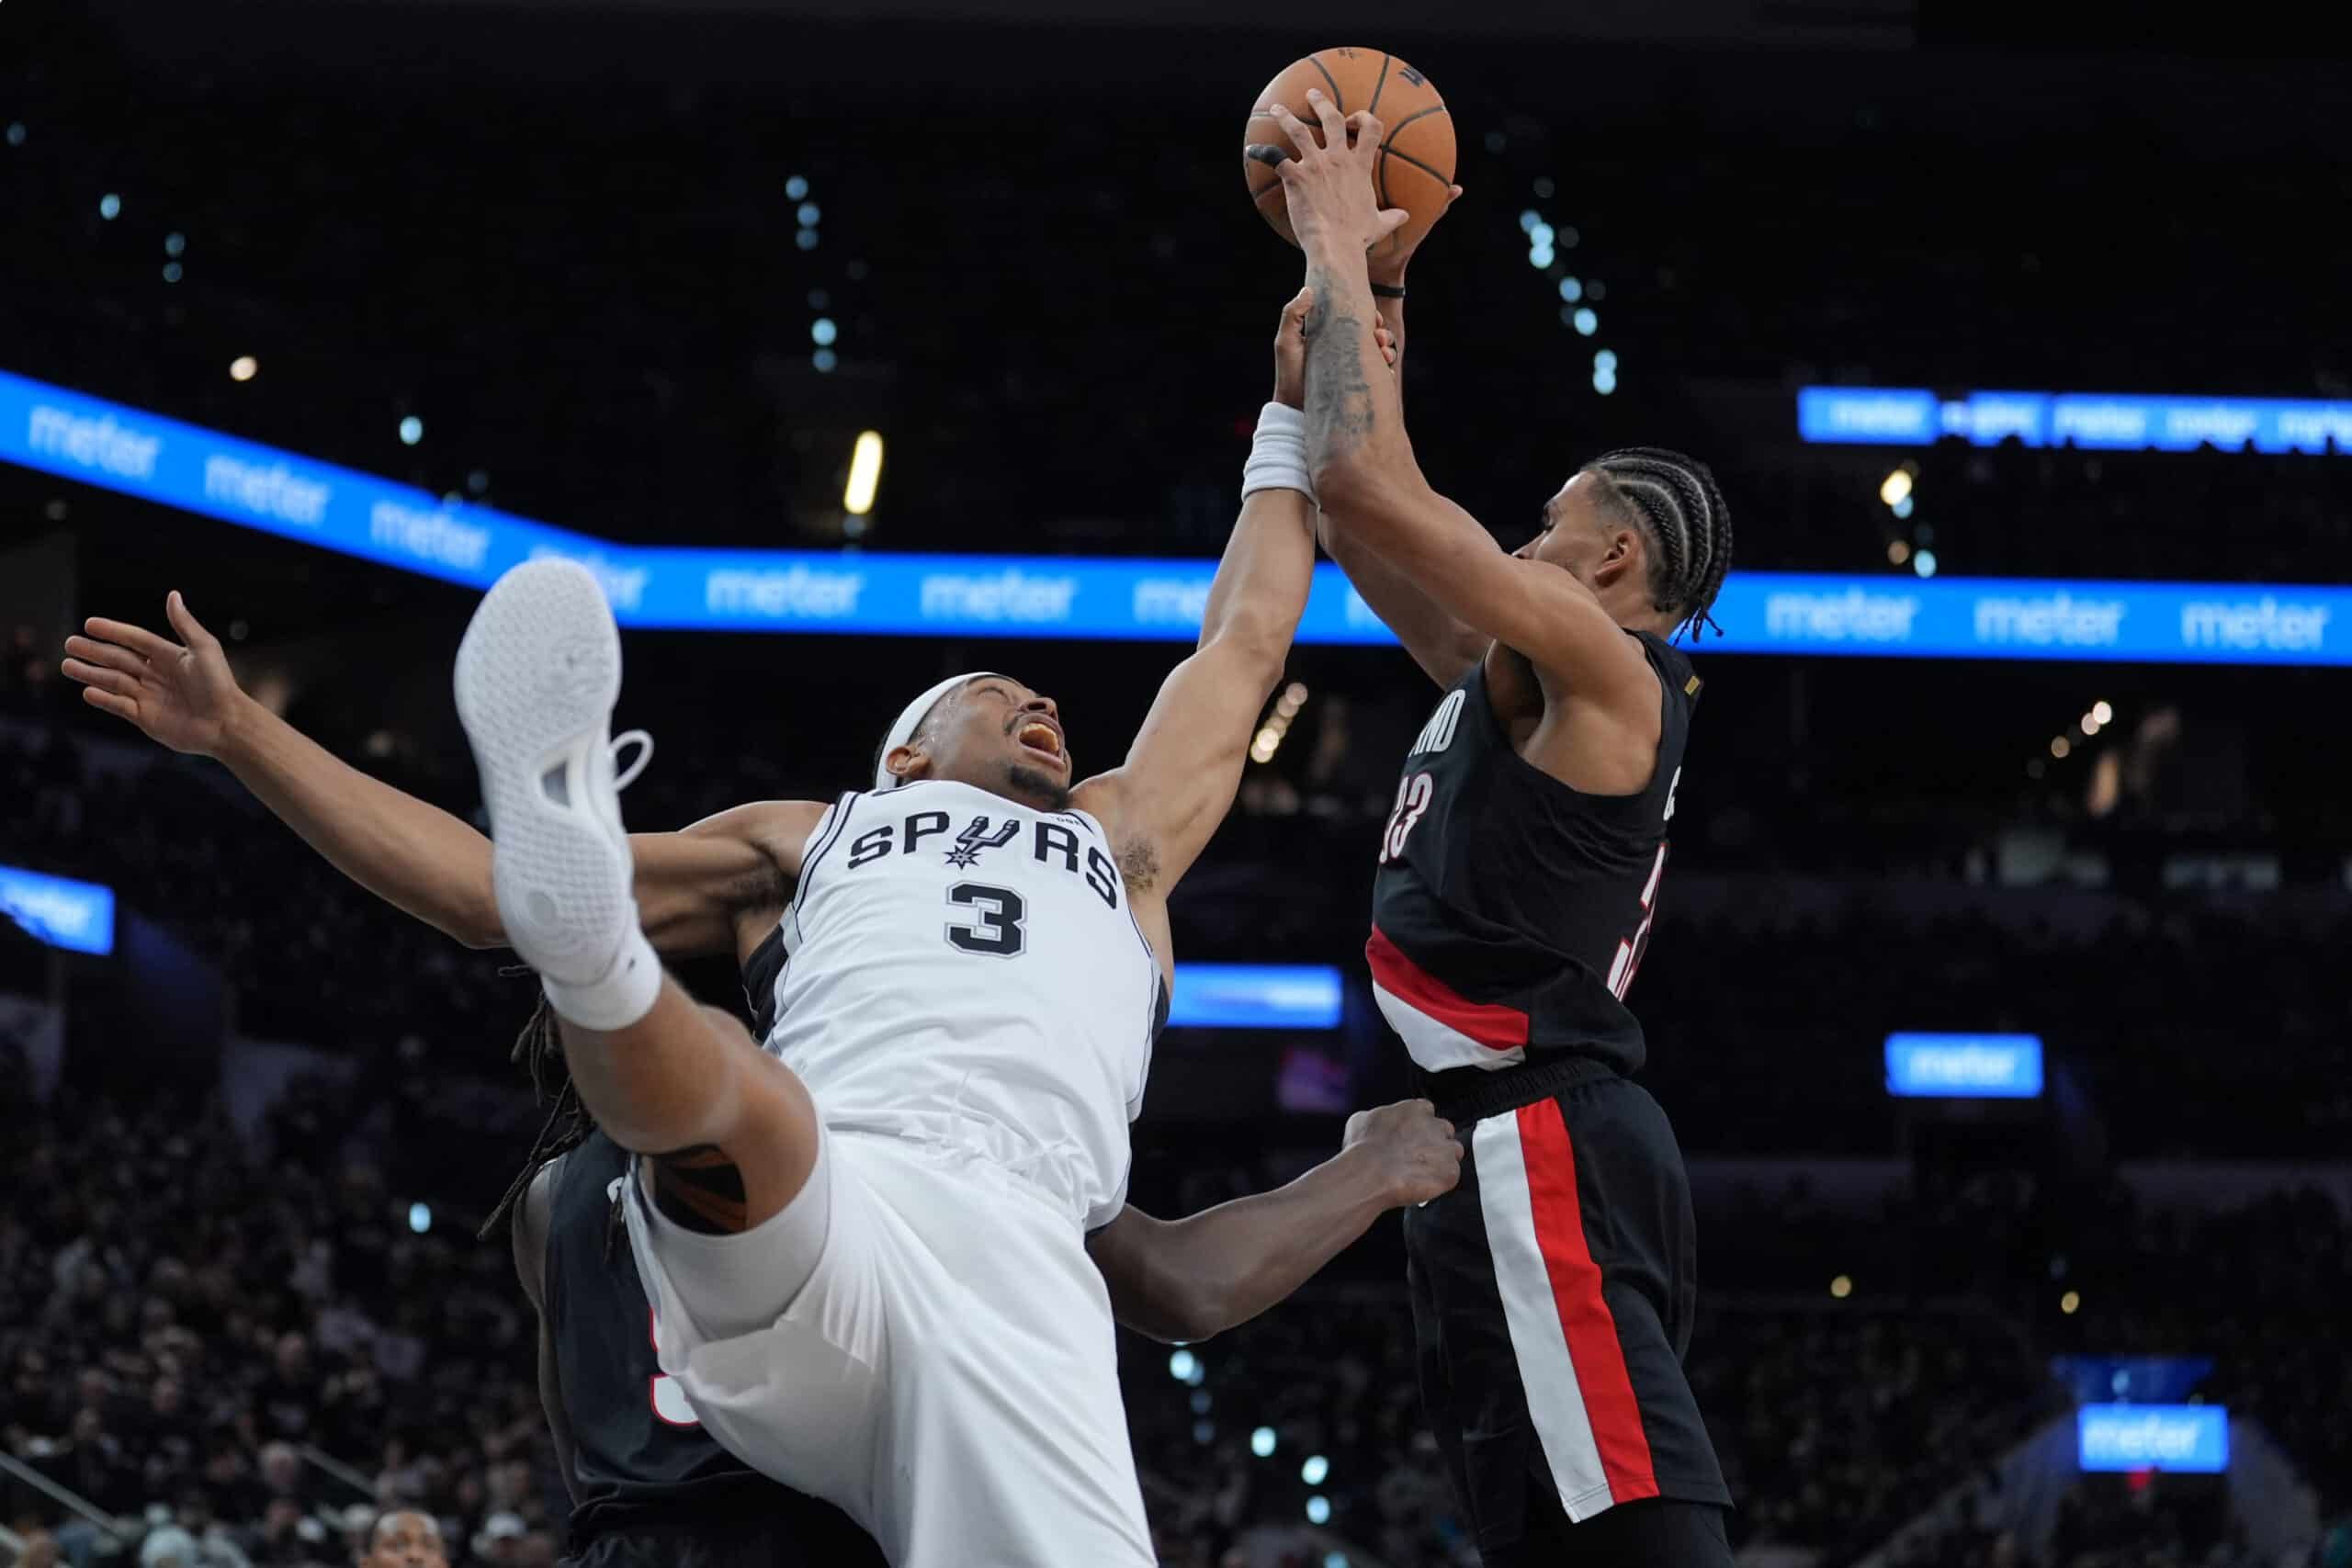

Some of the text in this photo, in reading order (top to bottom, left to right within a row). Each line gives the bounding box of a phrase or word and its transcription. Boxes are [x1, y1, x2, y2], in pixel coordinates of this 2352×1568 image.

[28, 404, 159, 478] meter
[204, 455, 329, 525] meter
[707, 565, 862, 615] meter
[921, 570, 1076, 620] meter
[1766, 590, 1917, 638] meter
[1973, 593, 2124, 645] meter
[2180, 597, 2329, 649] meter
[847, 809, 1118, 910] SPURS
[944, 880, 1029, 960] 3
